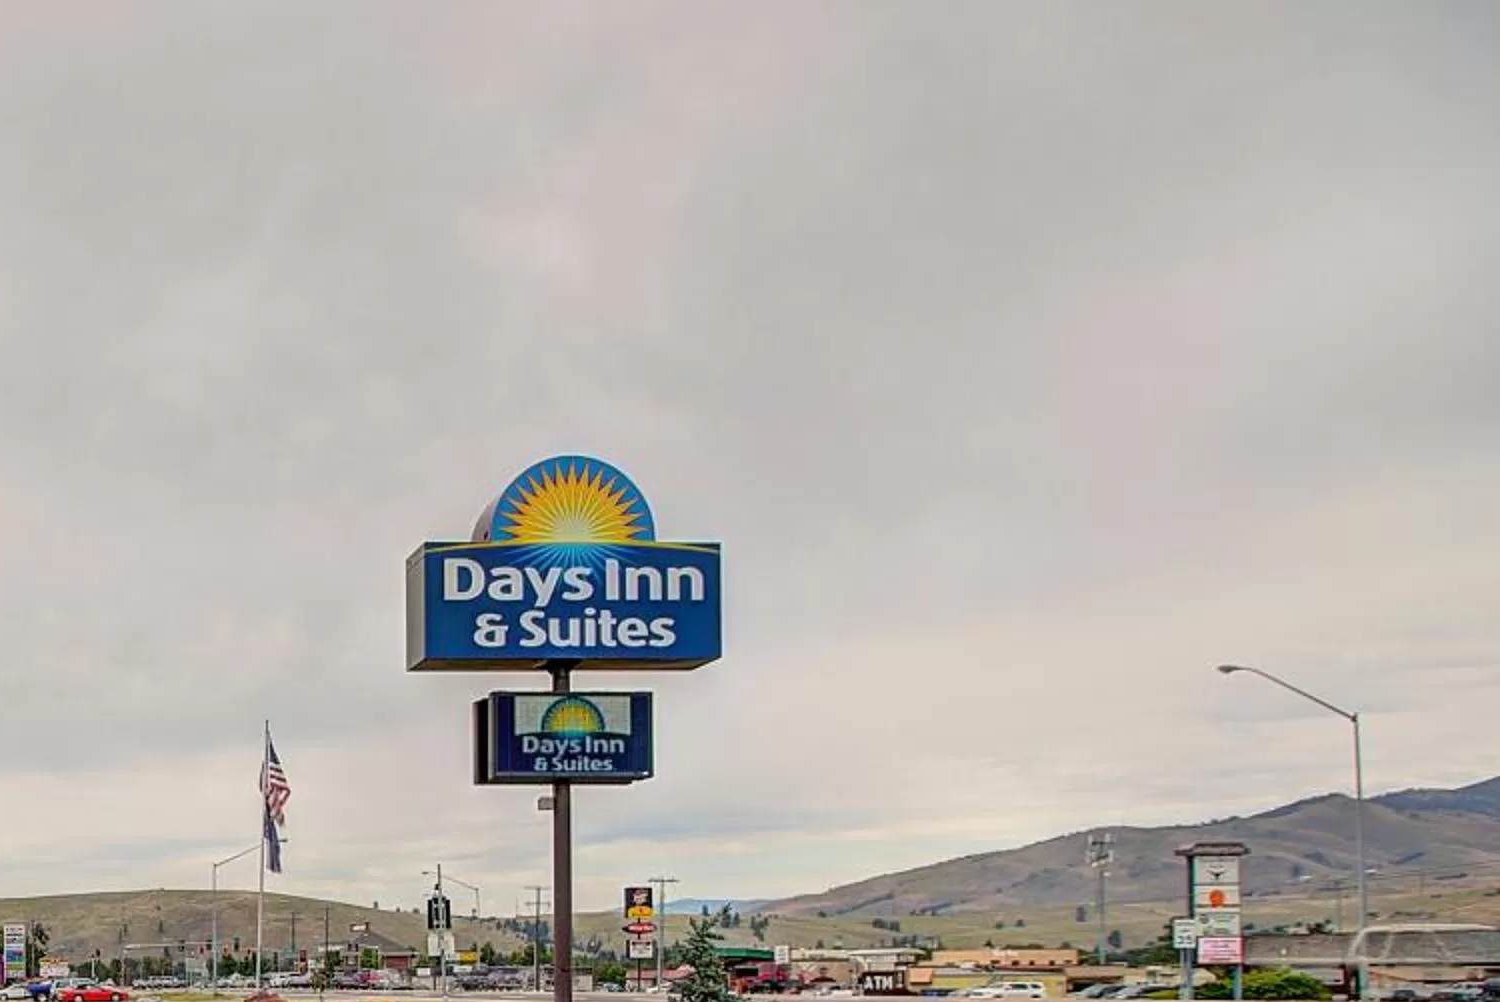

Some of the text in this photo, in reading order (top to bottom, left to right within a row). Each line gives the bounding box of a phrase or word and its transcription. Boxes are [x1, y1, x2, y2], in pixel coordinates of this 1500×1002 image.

[443, 558, 704, 607] Days Inn
[473, 607, 677, 648] & Suites
[522, 736, 625, 758] Days Inn
[535, 756, 613, 771] & Suites
[864, 975, 893, 990] ATM
